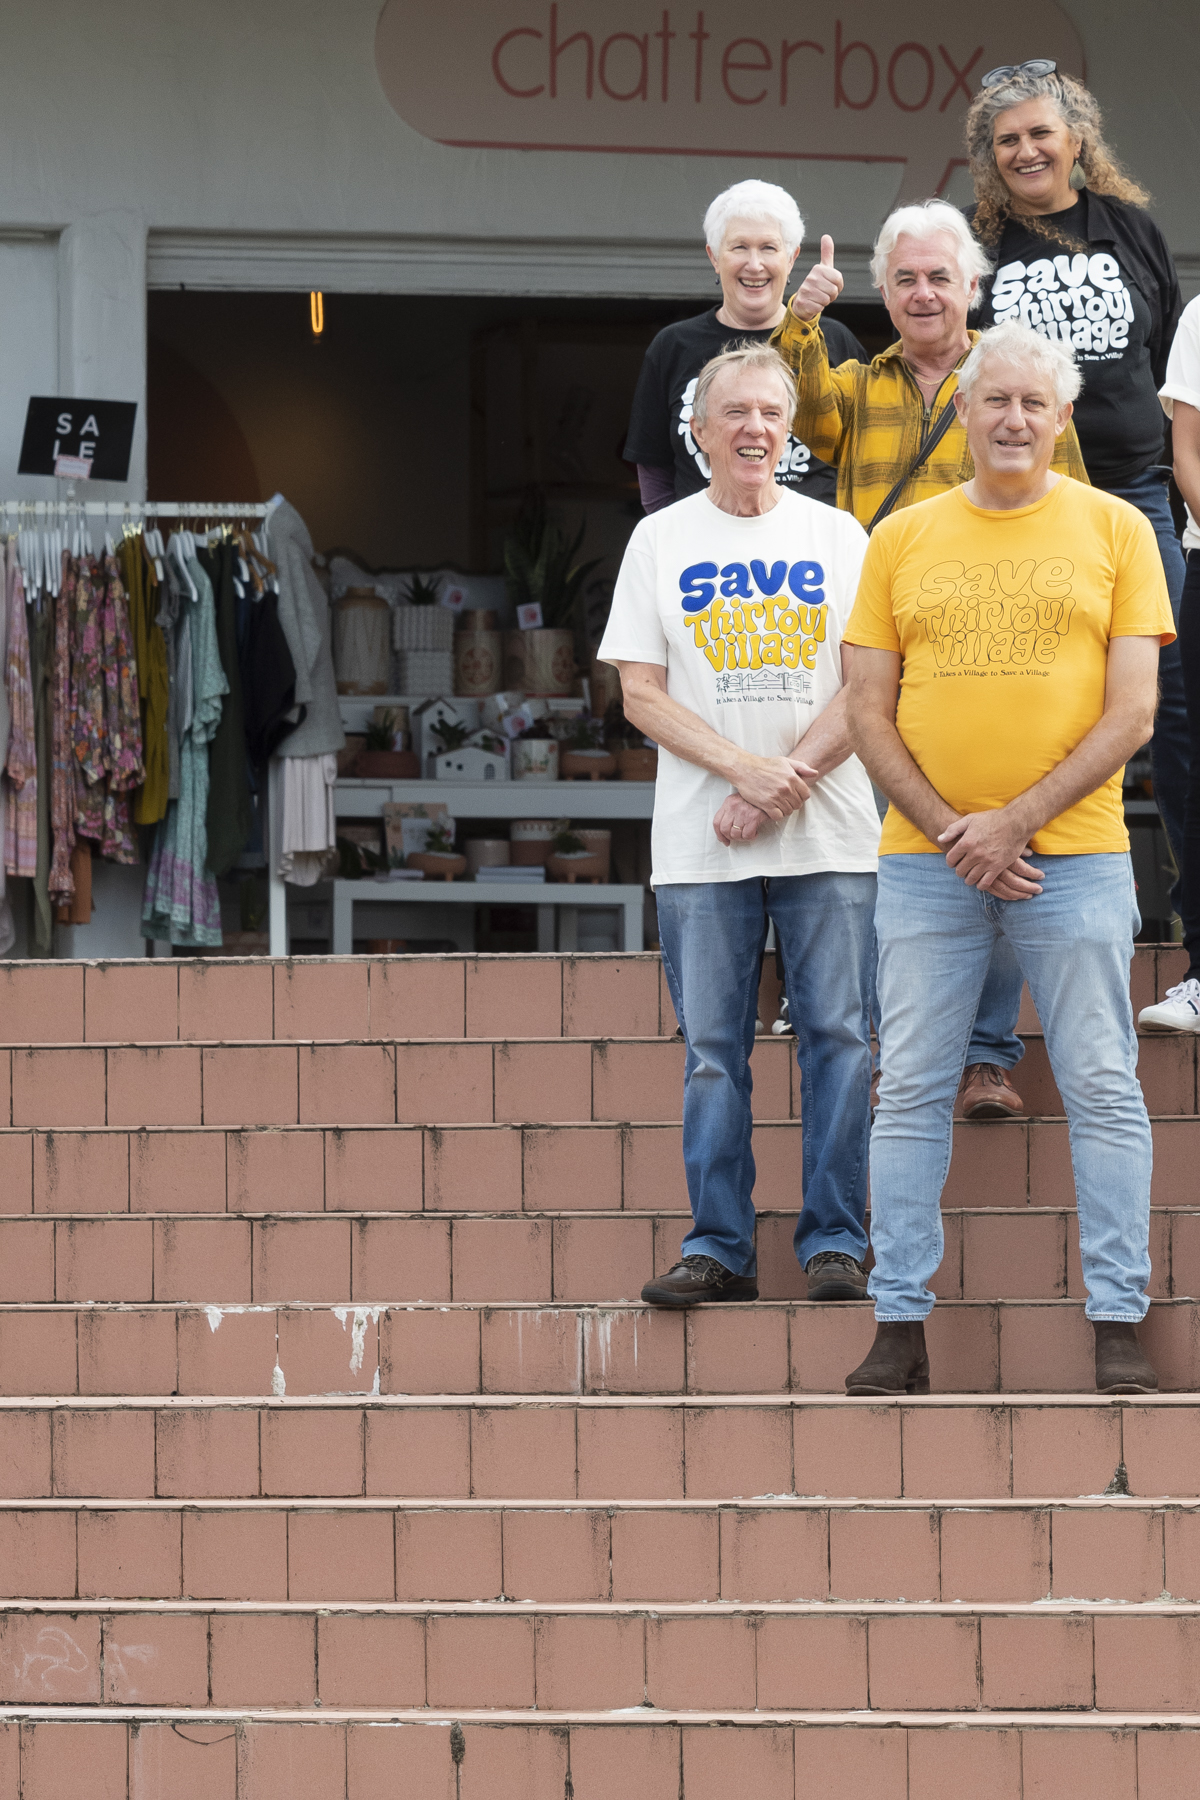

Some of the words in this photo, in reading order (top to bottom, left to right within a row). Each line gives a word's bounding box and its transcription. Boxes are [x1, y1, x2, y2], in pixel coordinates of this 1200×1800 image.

[491, 2, 984, 112] chatterbox
[1026, 669, 1050, 677] Village
[743, 695, 765, 703] Village
